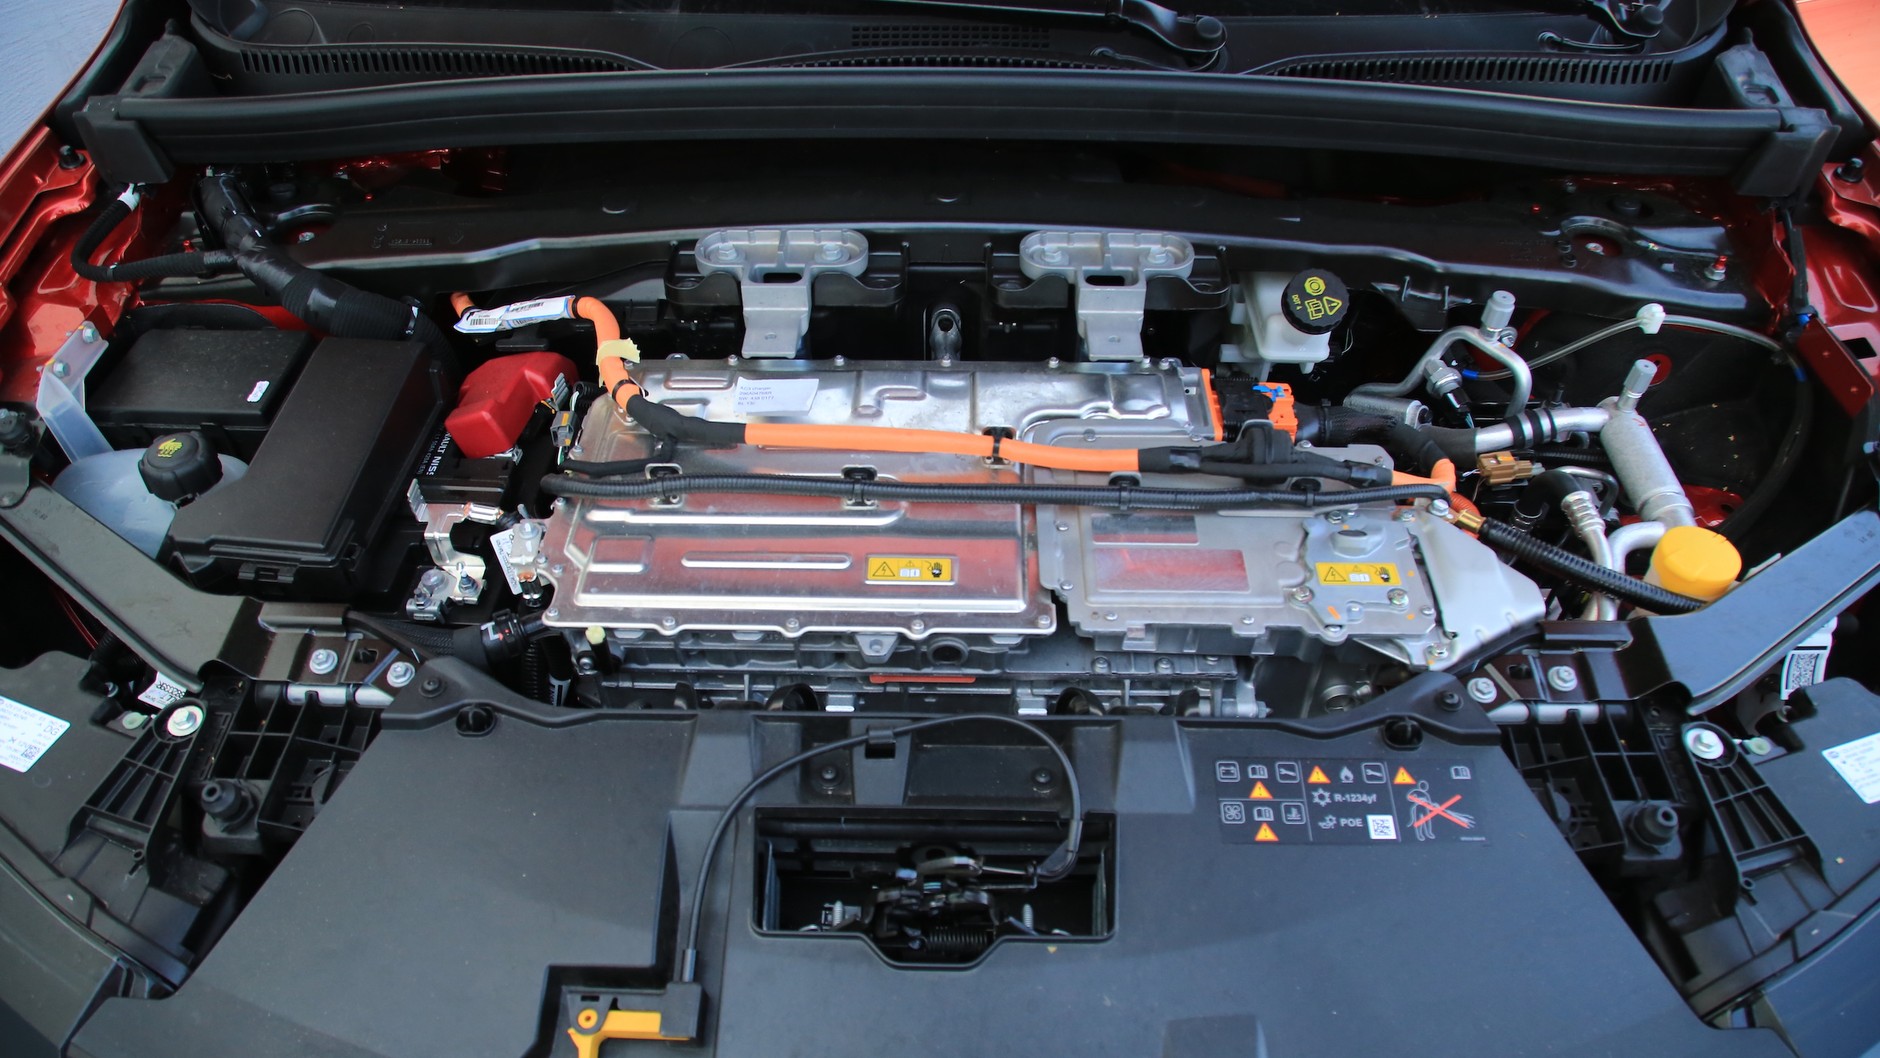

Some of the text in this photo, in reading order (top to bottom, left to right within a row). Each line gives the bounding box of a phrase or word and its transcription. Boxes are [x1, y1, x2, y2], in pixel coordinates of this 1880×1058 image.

[1292, 294, 1301, 304] DOT
[1334, 793, 1377, 804] R-1234yf
[1340, 818, 1363, 827] POE
